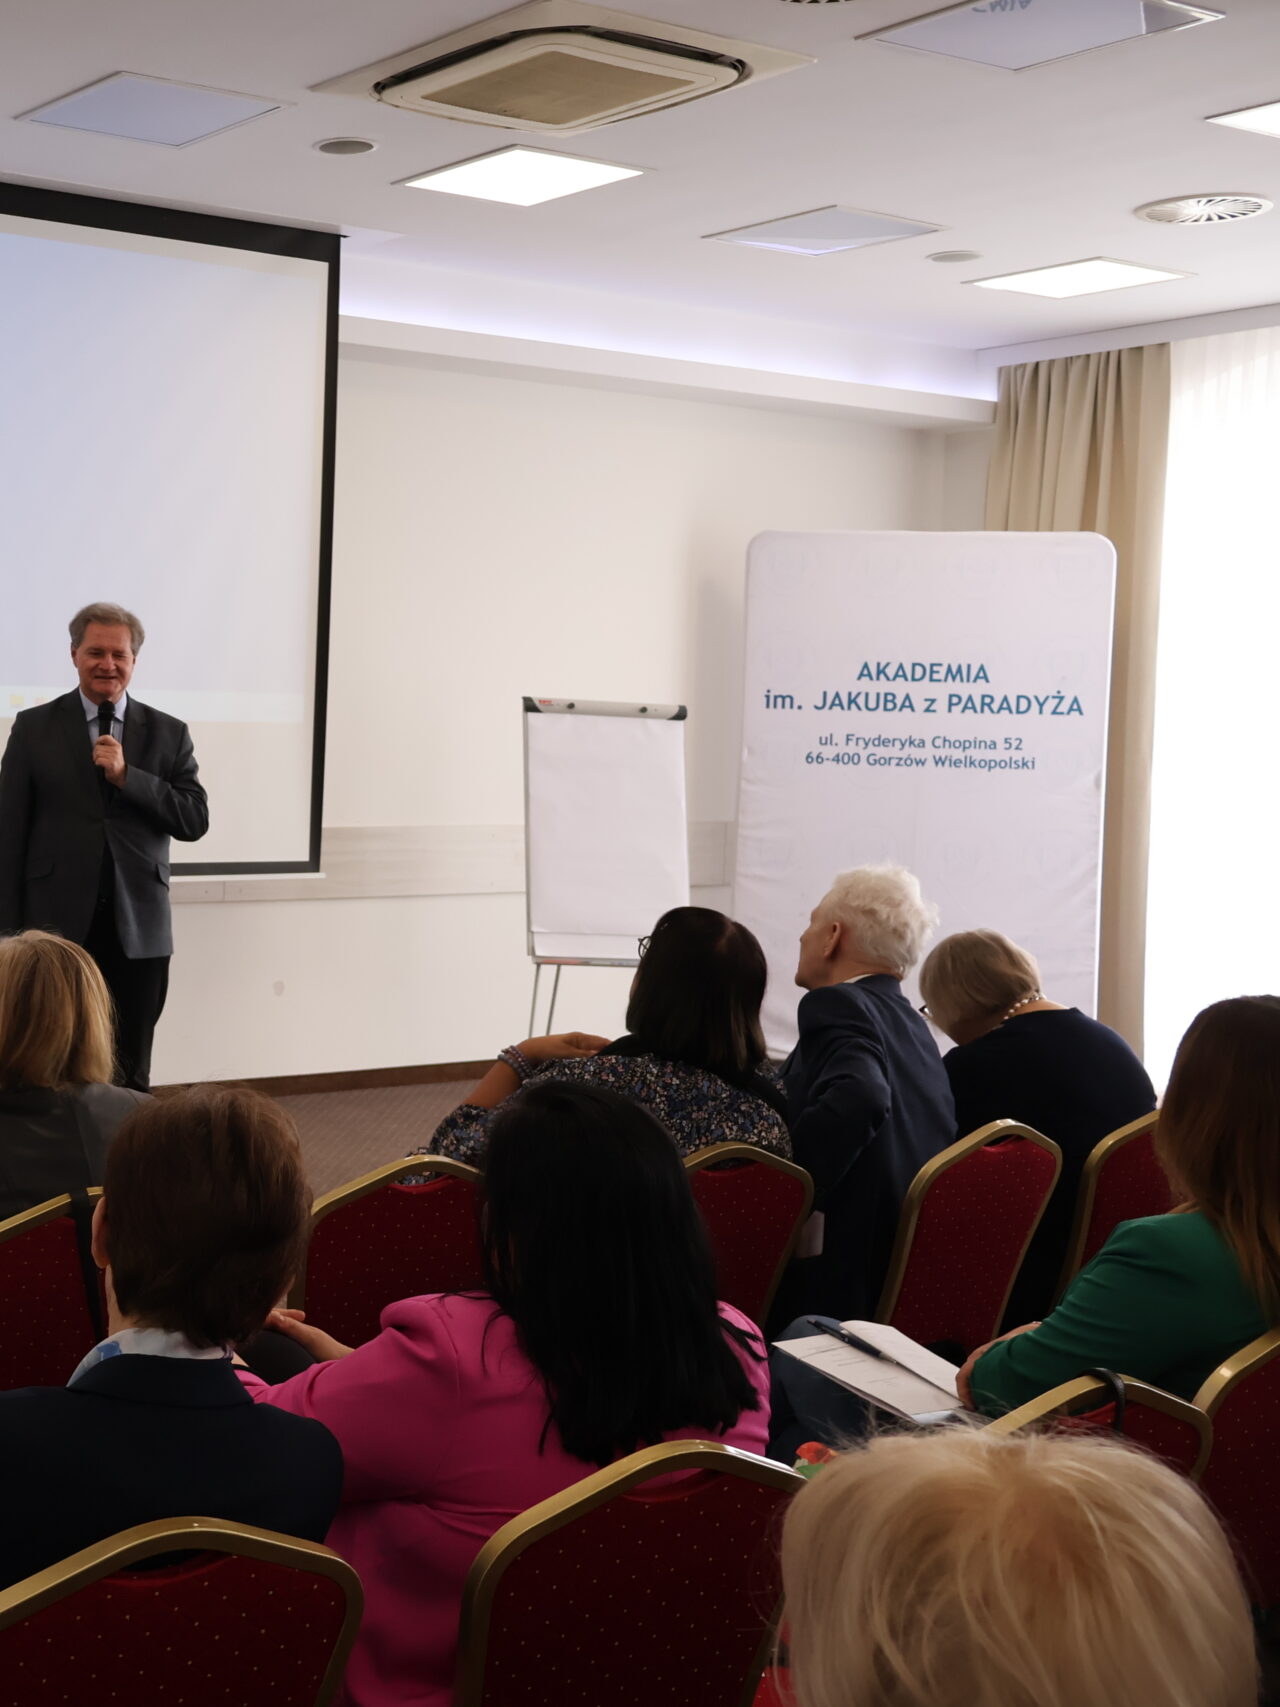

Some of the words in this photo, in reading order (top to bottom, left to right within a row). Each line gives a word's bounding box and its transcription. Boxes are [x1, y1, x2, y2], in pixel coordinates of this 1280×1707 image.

[856, 661, 991, 684] AKADEMIA
[764, 689, 803, 710] im.
[813, 690, 916, 713] JAKUBA
[923, 697, 938, 714] z
[947, 690, 1085, 717] PARADYŻA
[818, 733, 839, 747] ul.
[846, 734, 926, 751] Fryderyka
[931, 735, 998, 753] Chopina
[1003, 737, 1024, 751] 52
[805, 751, 862, 767] 66-400
[866, 752, 928, 768] Gorzów
[933, 754, 1036, 772] Wielkopolski
